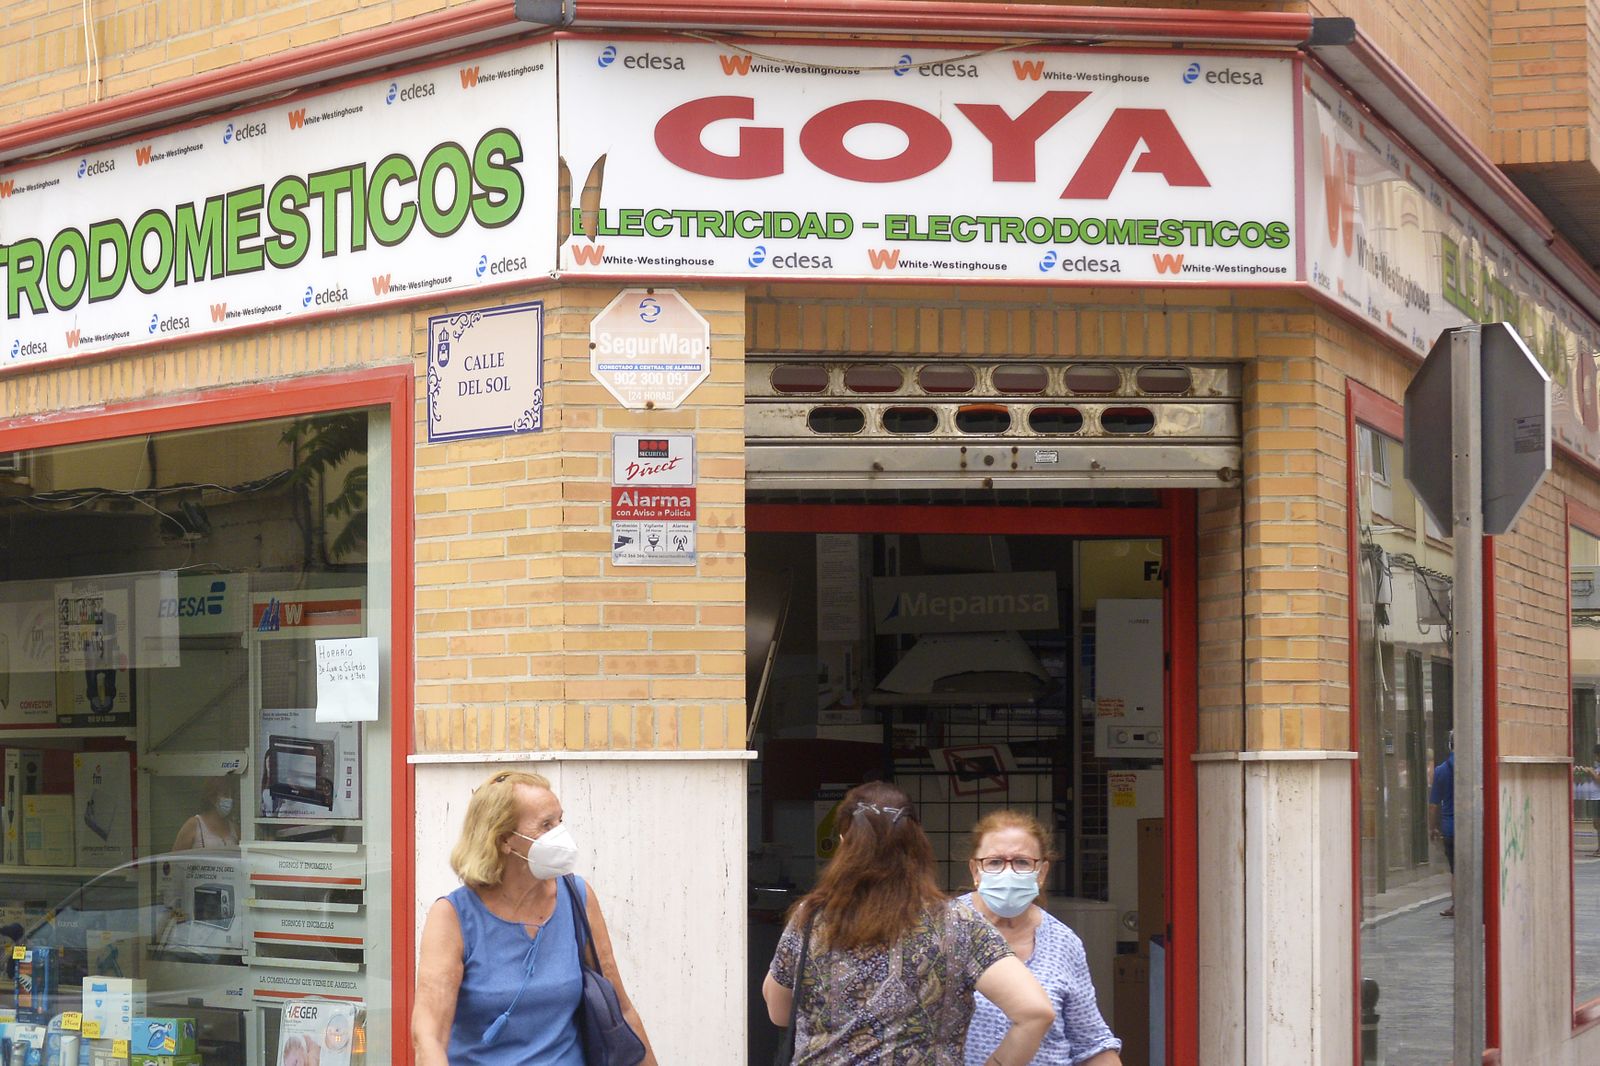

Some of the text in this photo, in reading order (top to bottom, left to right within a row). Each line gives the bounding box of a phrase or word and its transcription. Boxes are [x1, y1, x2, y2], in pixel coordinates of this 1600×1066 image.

[623, 53, 685, 70] edesa
[918, 61, 979, 78] edesa
[476, 62, 544, 85] White-Westinghouse
[1043, 71, 1150, 83] White-Westinghouse
[1205, 67, 1263, 85] edesa
[400, 81, 436, 105] edesa
[303, 104, 364, 126] White-Westinghouse
[235, 120, 267, 142] edesa
[150, 142, 204, 163] White-Westinghouse
[654, 90, 1212, 200] GOYA
[87, 157, 115, 178] edesa
[0, 127, 524, 320] RODOMESTICOS
[885, 214, 1290, 249] ELECTRODOMESTICOS
[490, 254, 528, 276] edesa
[602, 254, 714, 267] White-Westinghouse
[772, 252, 834, 269] edesa
[898, 259, 1007, 271] White-Westinghouse
[1062, 256, 1121, 273] edesa
[1182, 264, 1287, 274] White-Westinghouse
[388, 275, 453, 293] White-Westinghouse
[314, 286, 349, 306] edesa
[225, 303, 283, 321] White-Westinghouse
[159, 315, 190, 334] edesa
[79, 329, 131, 346] White-Westinghouse
[599, 332, 703, 358] SegurMap
[20, 340, 47, 357] edesa
[464, 352, 505, 371] CALLE
[458, 376, 511, 396] DEL SOL
[614, 372, 688, 385] 902 300 091
[626, 457, 684, 480] Direct
[616, 491, 690, 507] Alarma
[159, 598, 206, 618] EDESA
[901, 592, 1049, 623] Mepamsa
